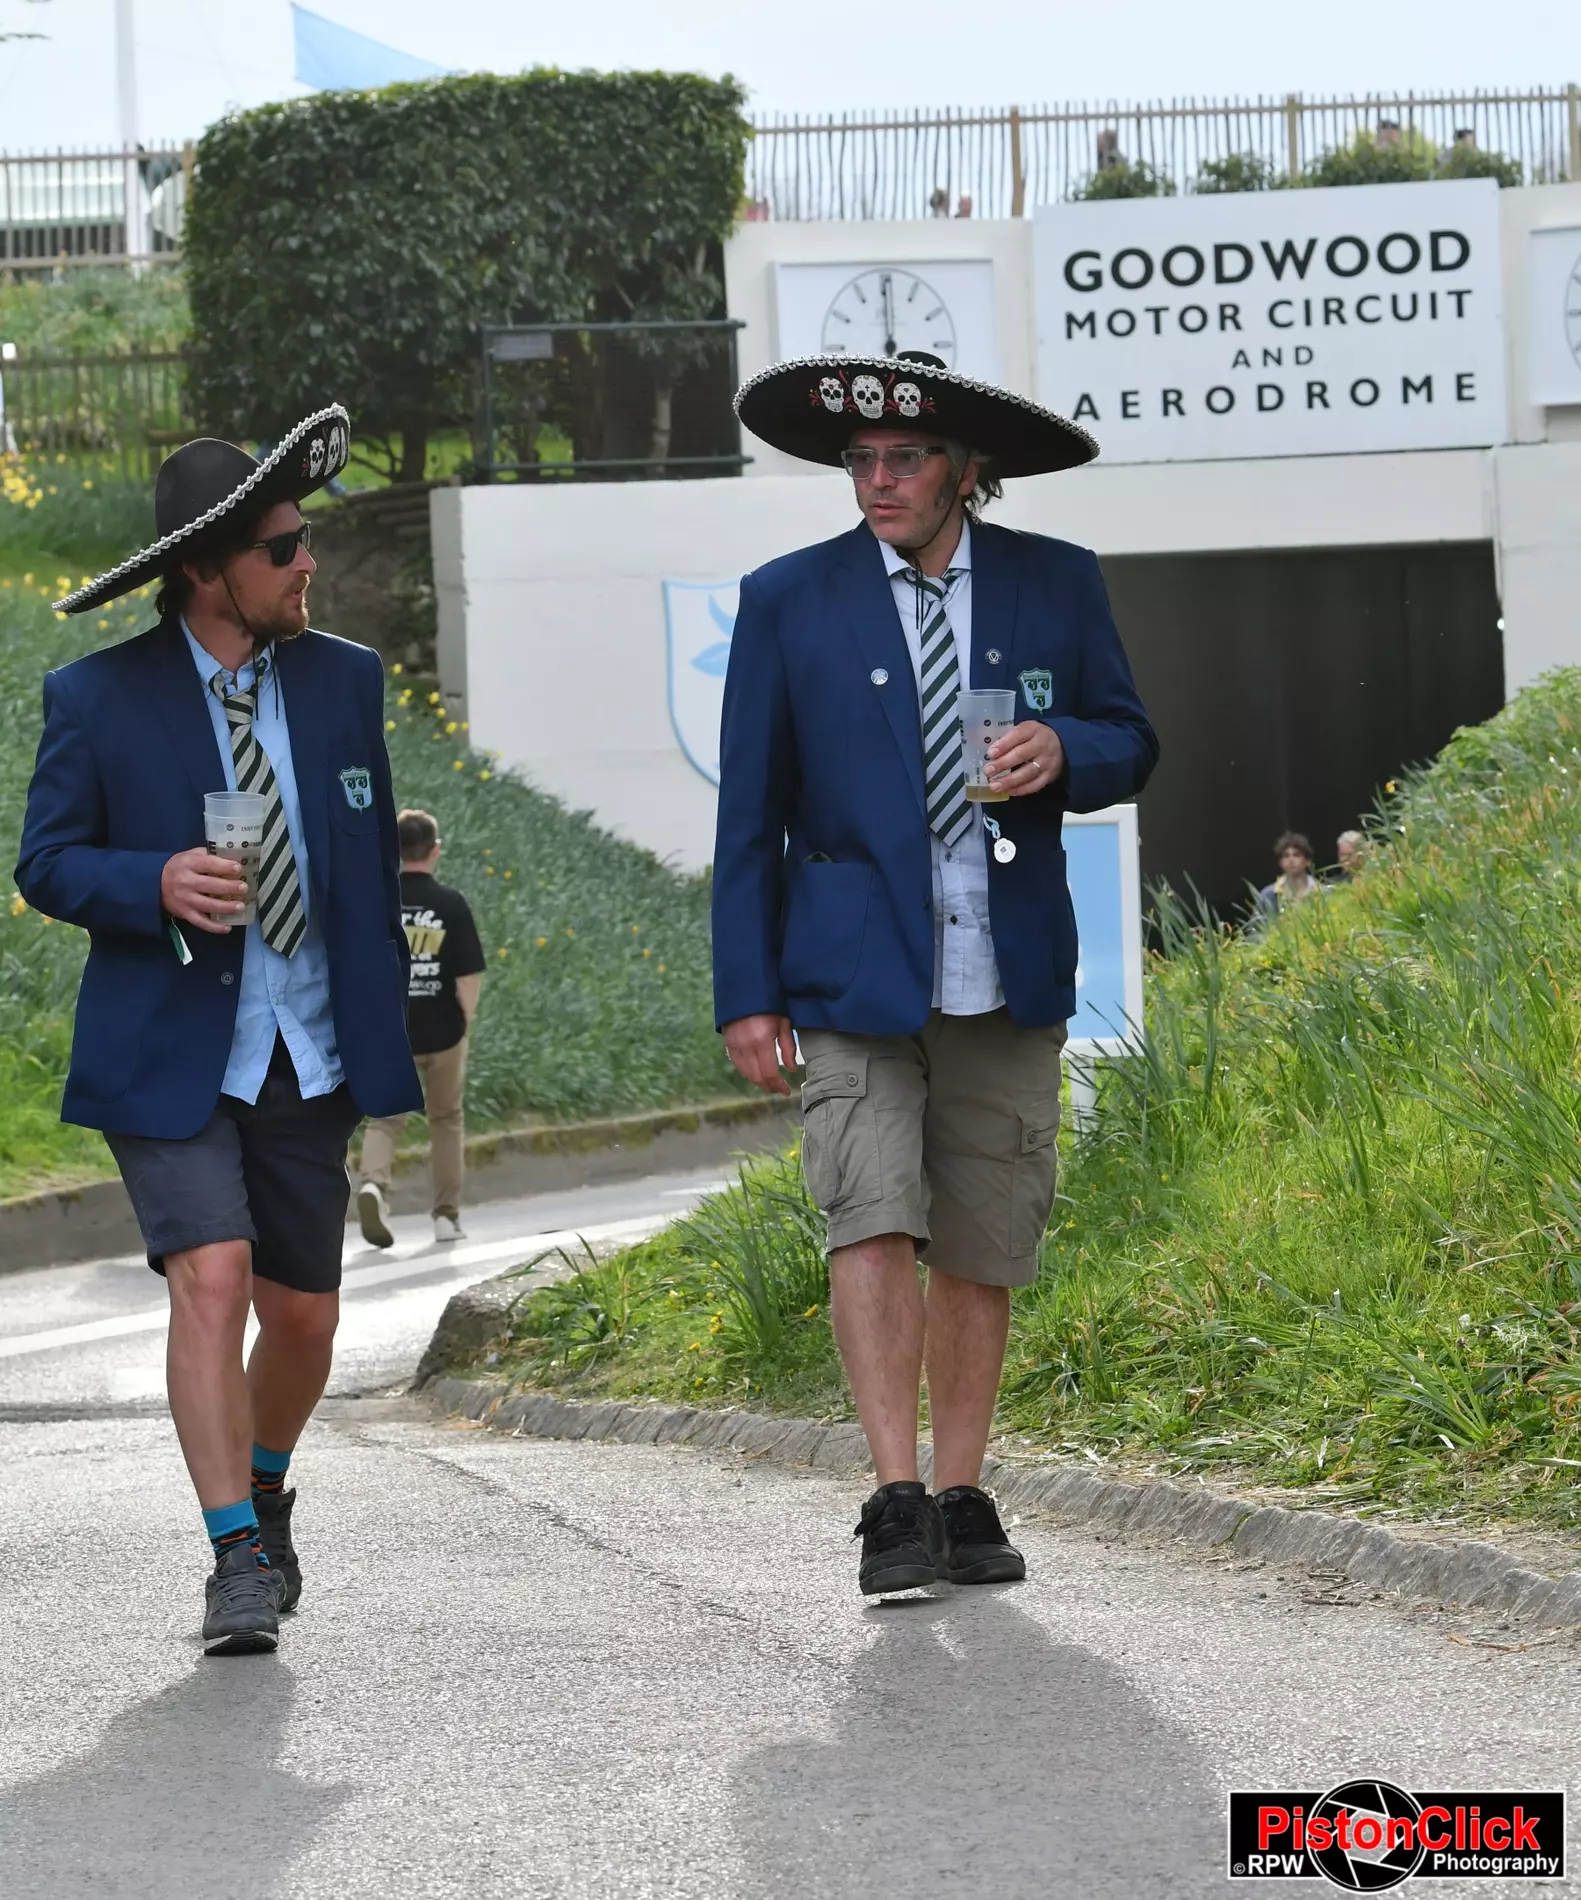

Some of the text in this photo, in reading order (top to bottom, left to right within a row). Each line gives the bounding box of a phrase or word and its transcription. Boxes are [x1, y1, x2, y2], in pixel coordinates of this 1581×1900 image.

[1063, 229, 1472, 294] GOODWOOD
[1065, 289, 1473, 340] MOTOR CIRCUIT
[1231, 345, 1315, 370] AND
[1072, 372, 1477, 421] AERODROME
